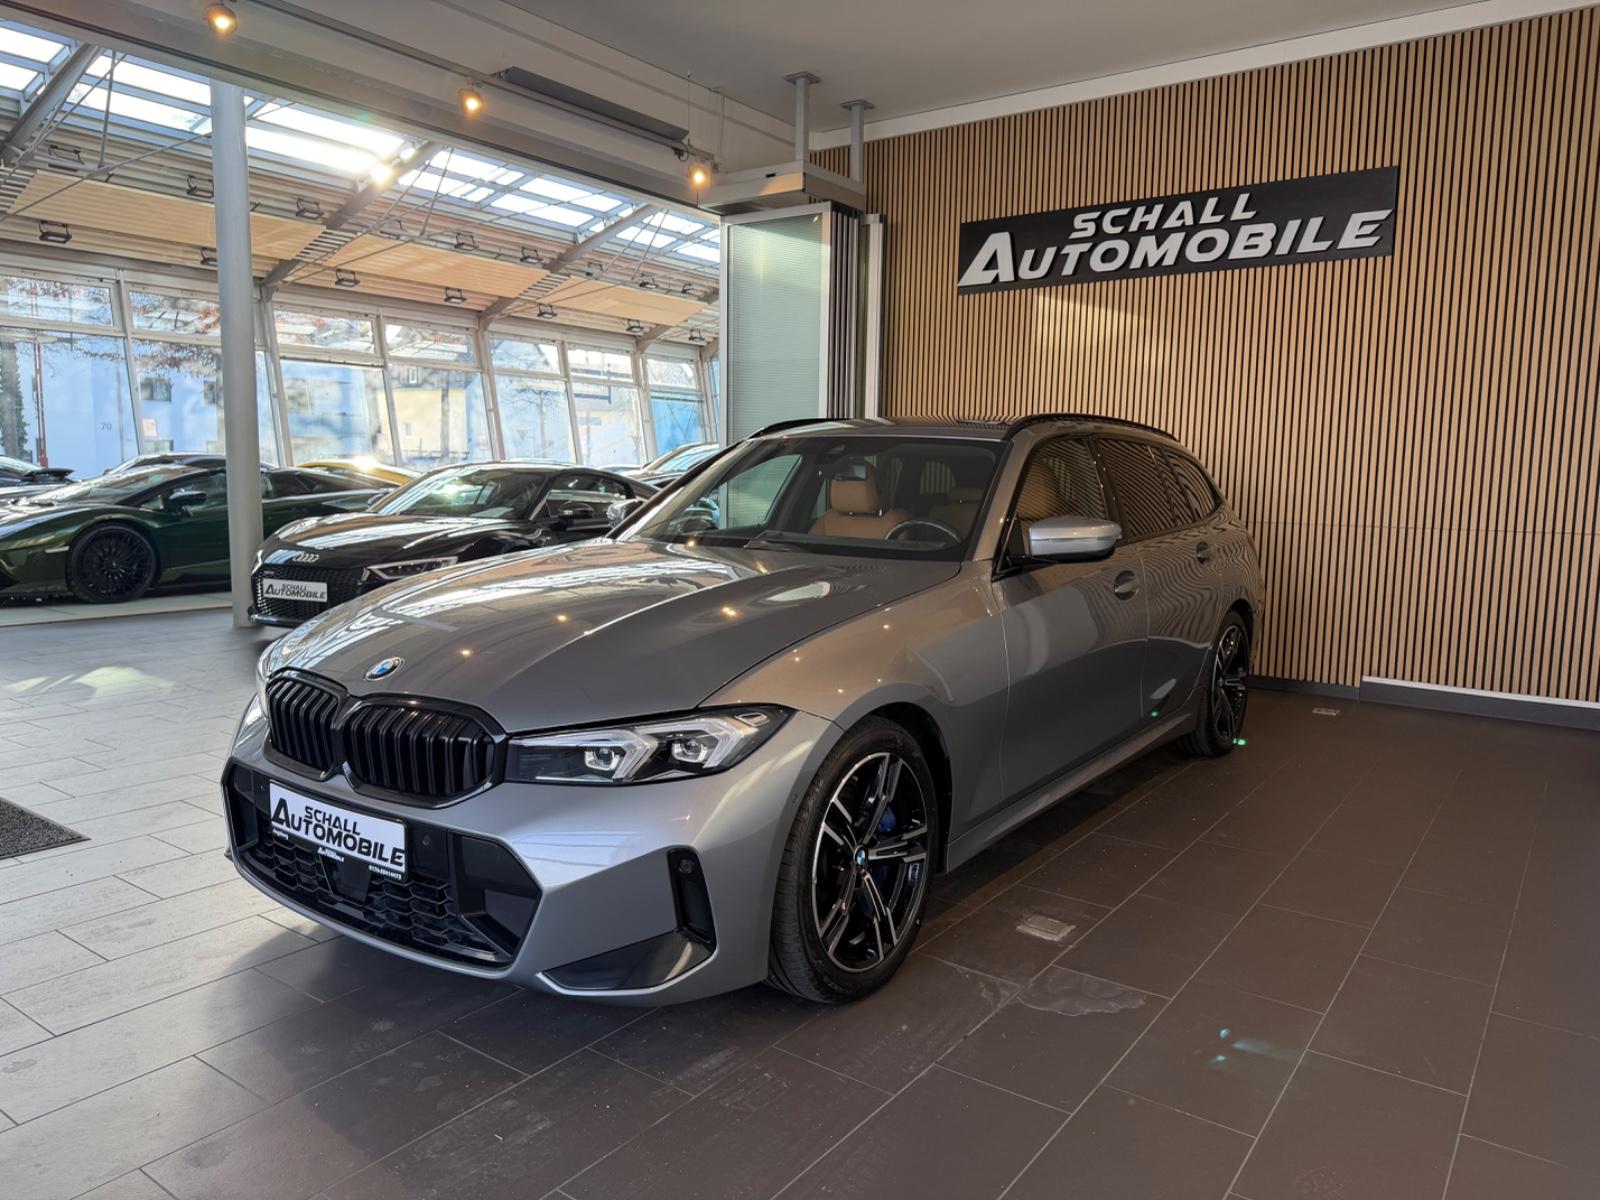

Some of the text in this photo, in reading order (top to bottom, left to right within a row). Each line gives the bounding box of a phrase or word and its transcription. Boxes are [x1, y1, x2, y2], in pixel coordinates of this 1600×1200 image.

[1069, 193, 1257, 239] SCHALL
[957, 208, 1394, 287] AUTOMOBILE
[100, 422, 112, 431] 70
[265, 583, 326, 599] AUTOMOBILE
[282, 583, 307, 591] SCHALL
[271, 797, 405, 867] AUTOMOBILE
[304, 805, 361, 836] SCHALL
